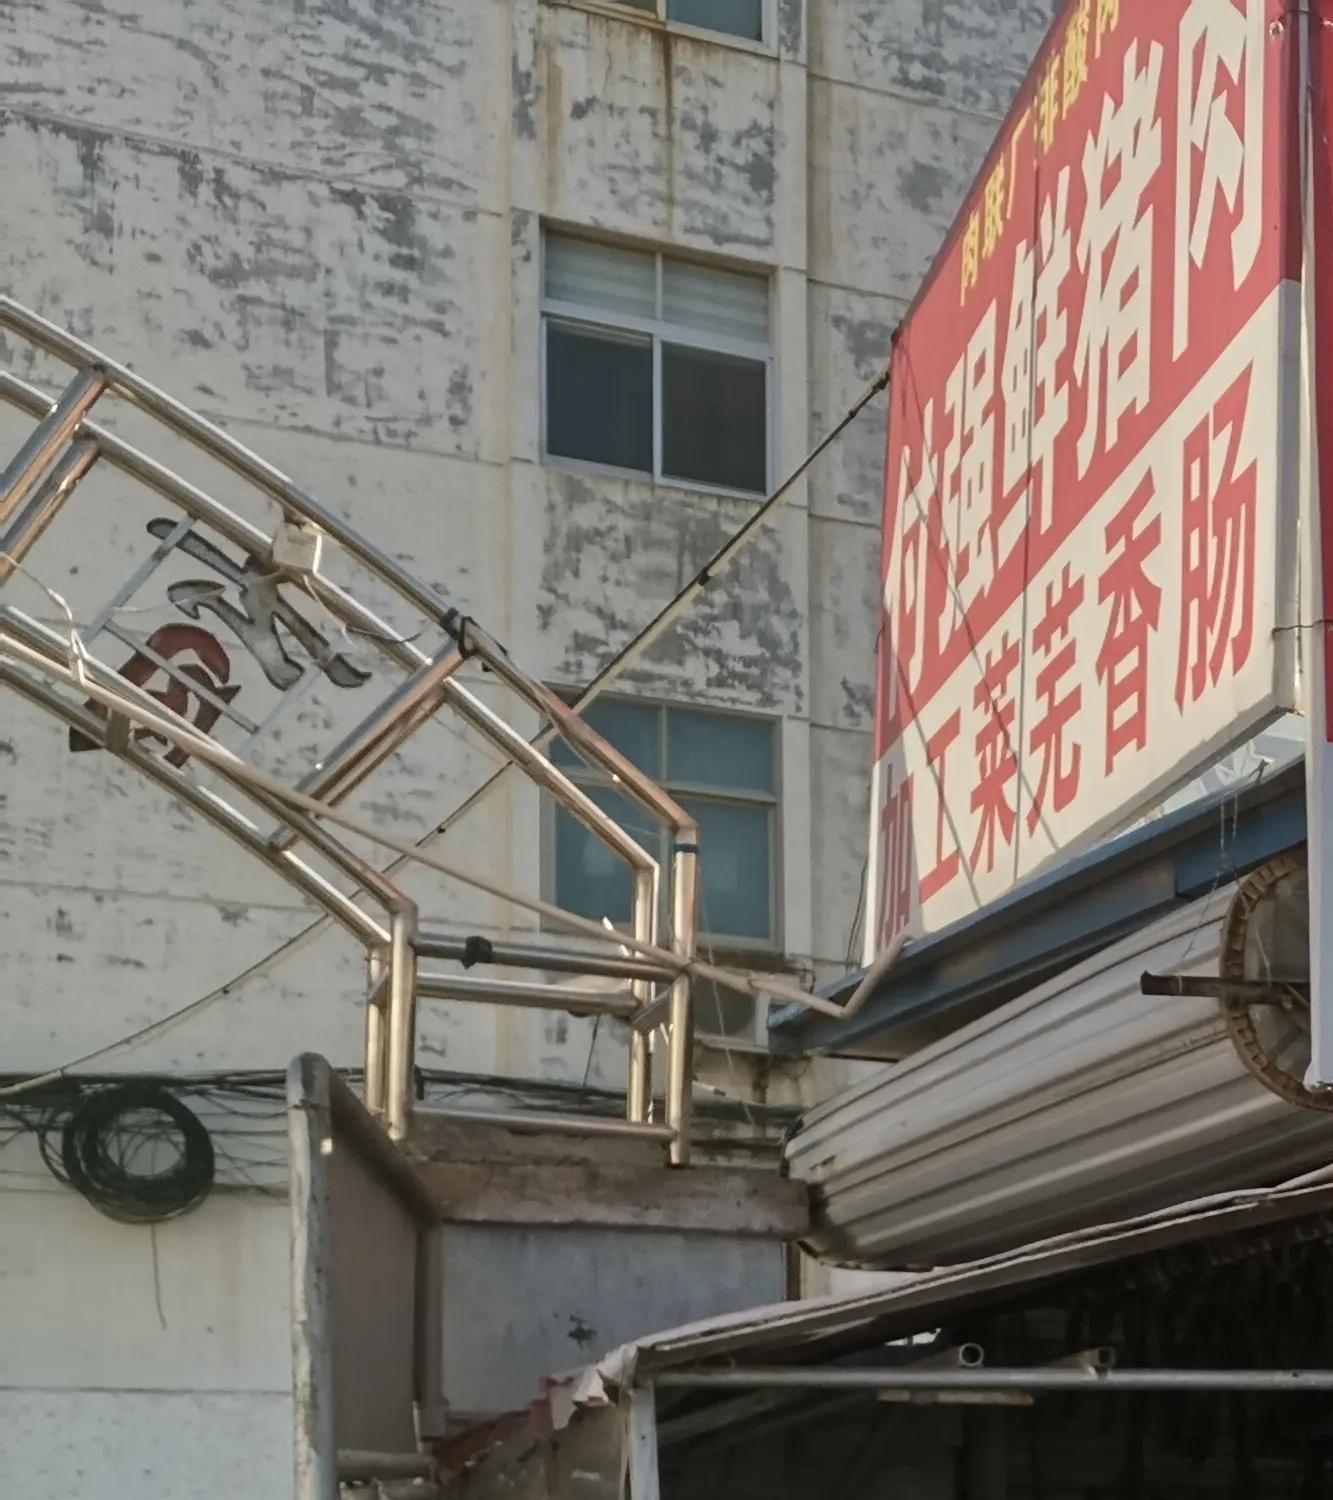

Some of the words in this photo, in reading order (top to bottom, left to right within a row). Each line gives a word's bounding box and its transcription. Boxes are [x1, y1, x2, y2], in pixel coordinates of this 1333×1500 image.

[875, 357, 1259, 948] 加工莱芜香肠
